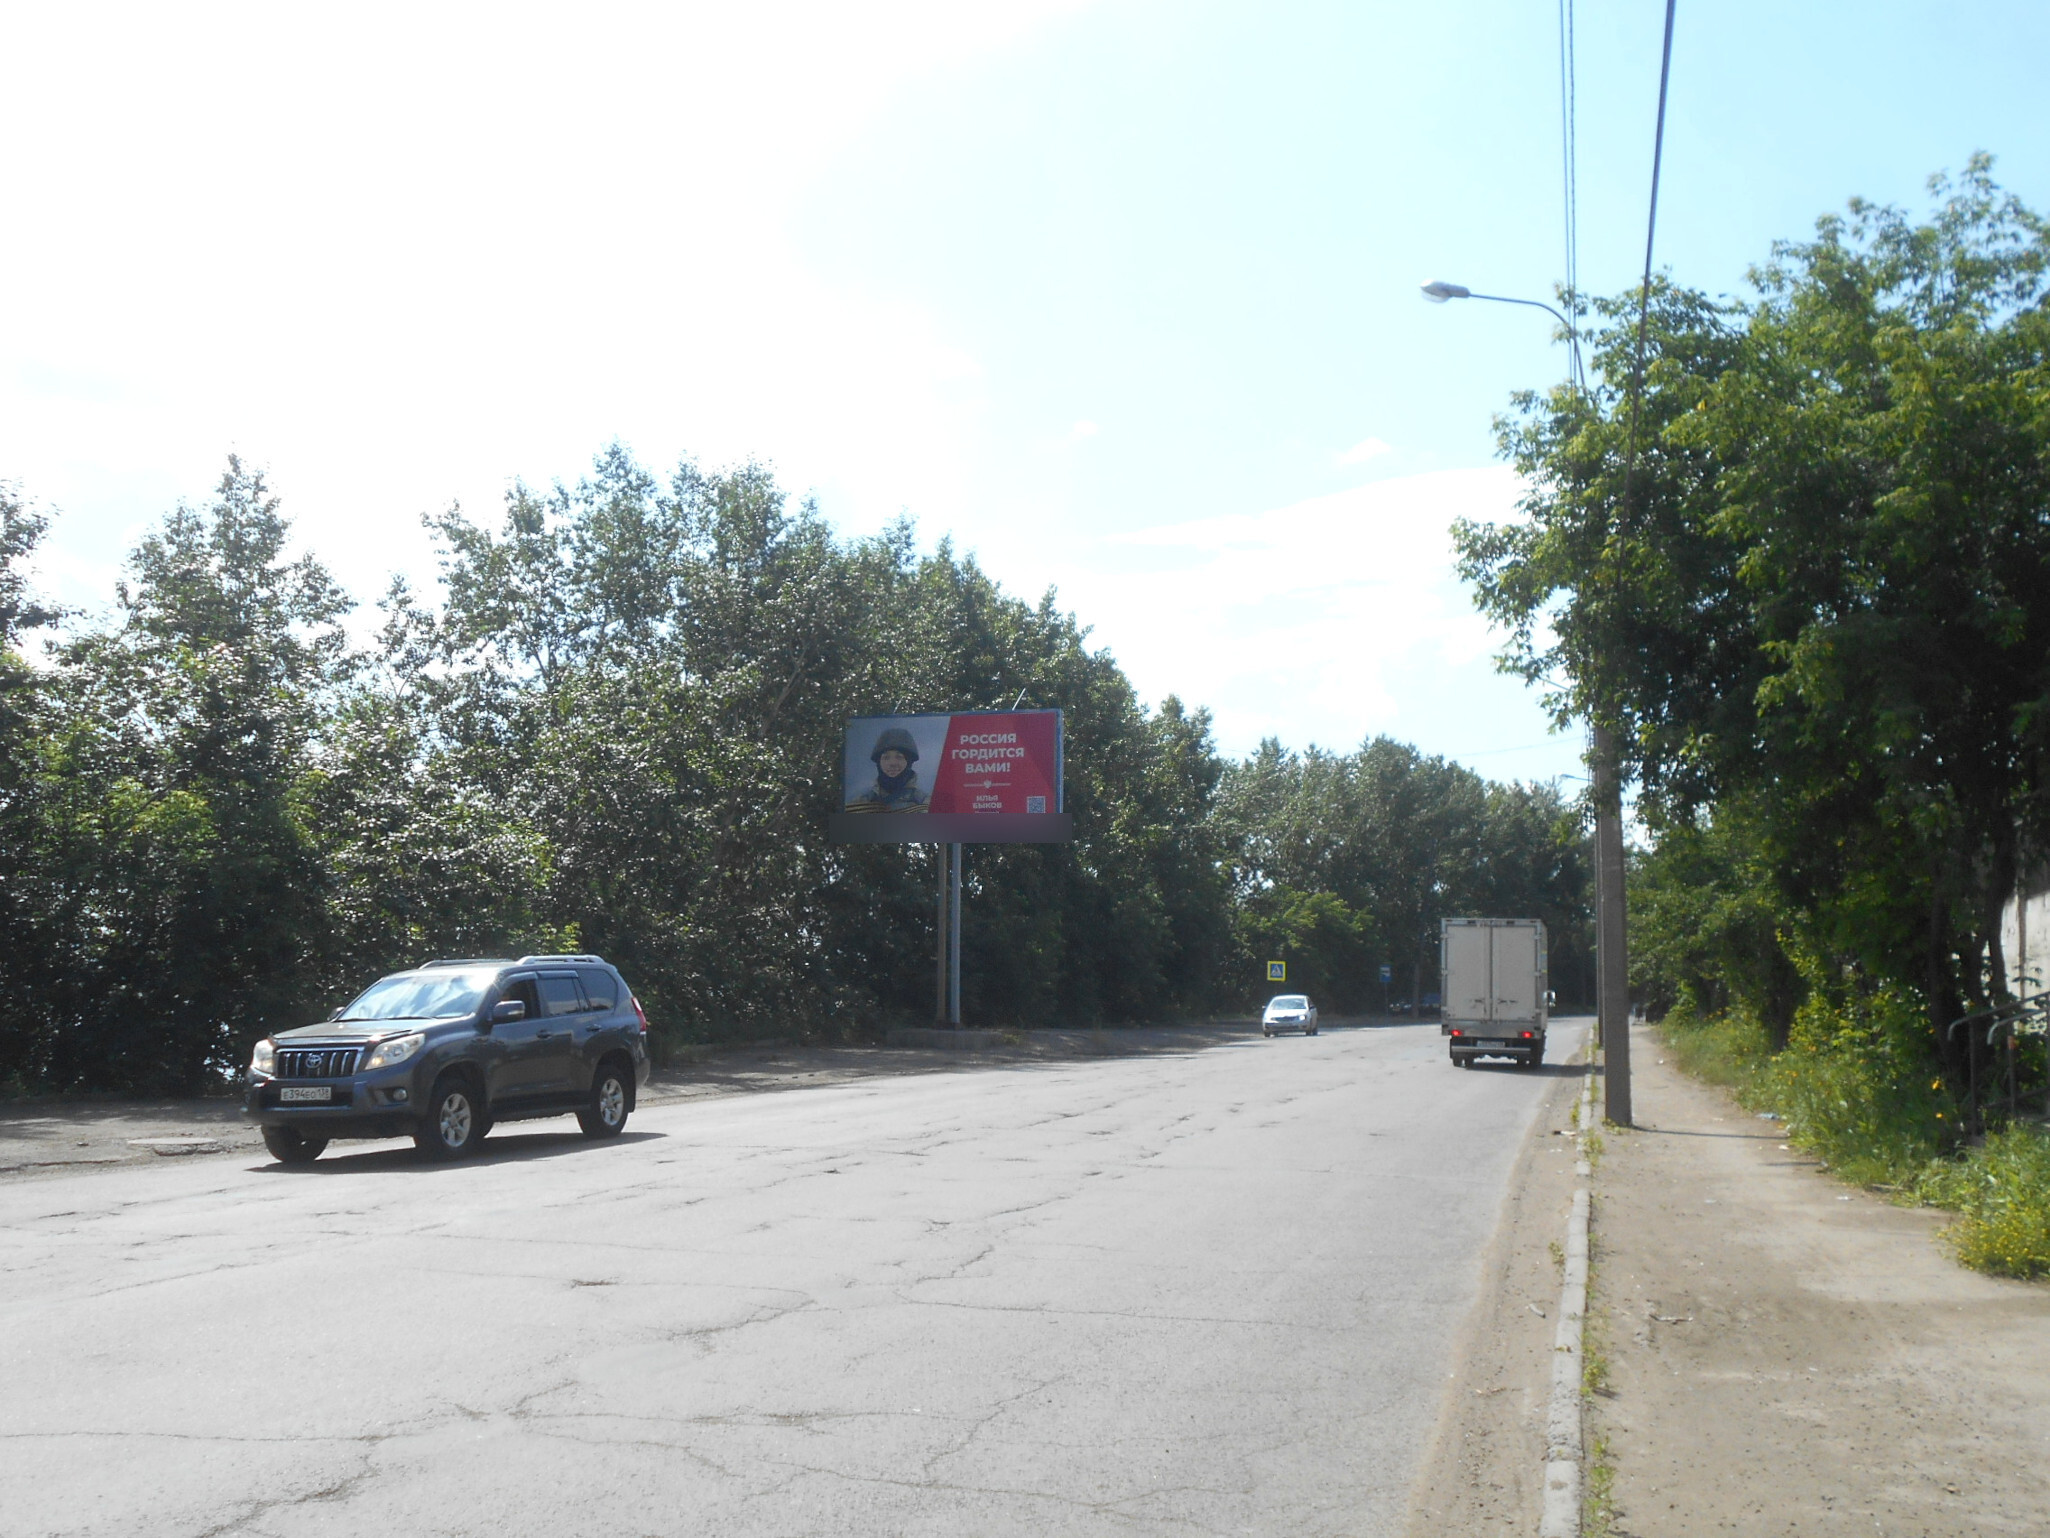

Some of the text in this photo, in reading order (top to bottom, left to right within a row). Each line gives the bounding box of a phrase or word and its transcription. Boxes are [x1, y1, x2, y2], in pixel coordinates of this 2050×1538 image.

[960, 733, 1017, 745] РОССИЯ
[951, 748, 1025, 760] ГОРДИТСЯ
[965, 762, 1011, 774] ВАМИ!
